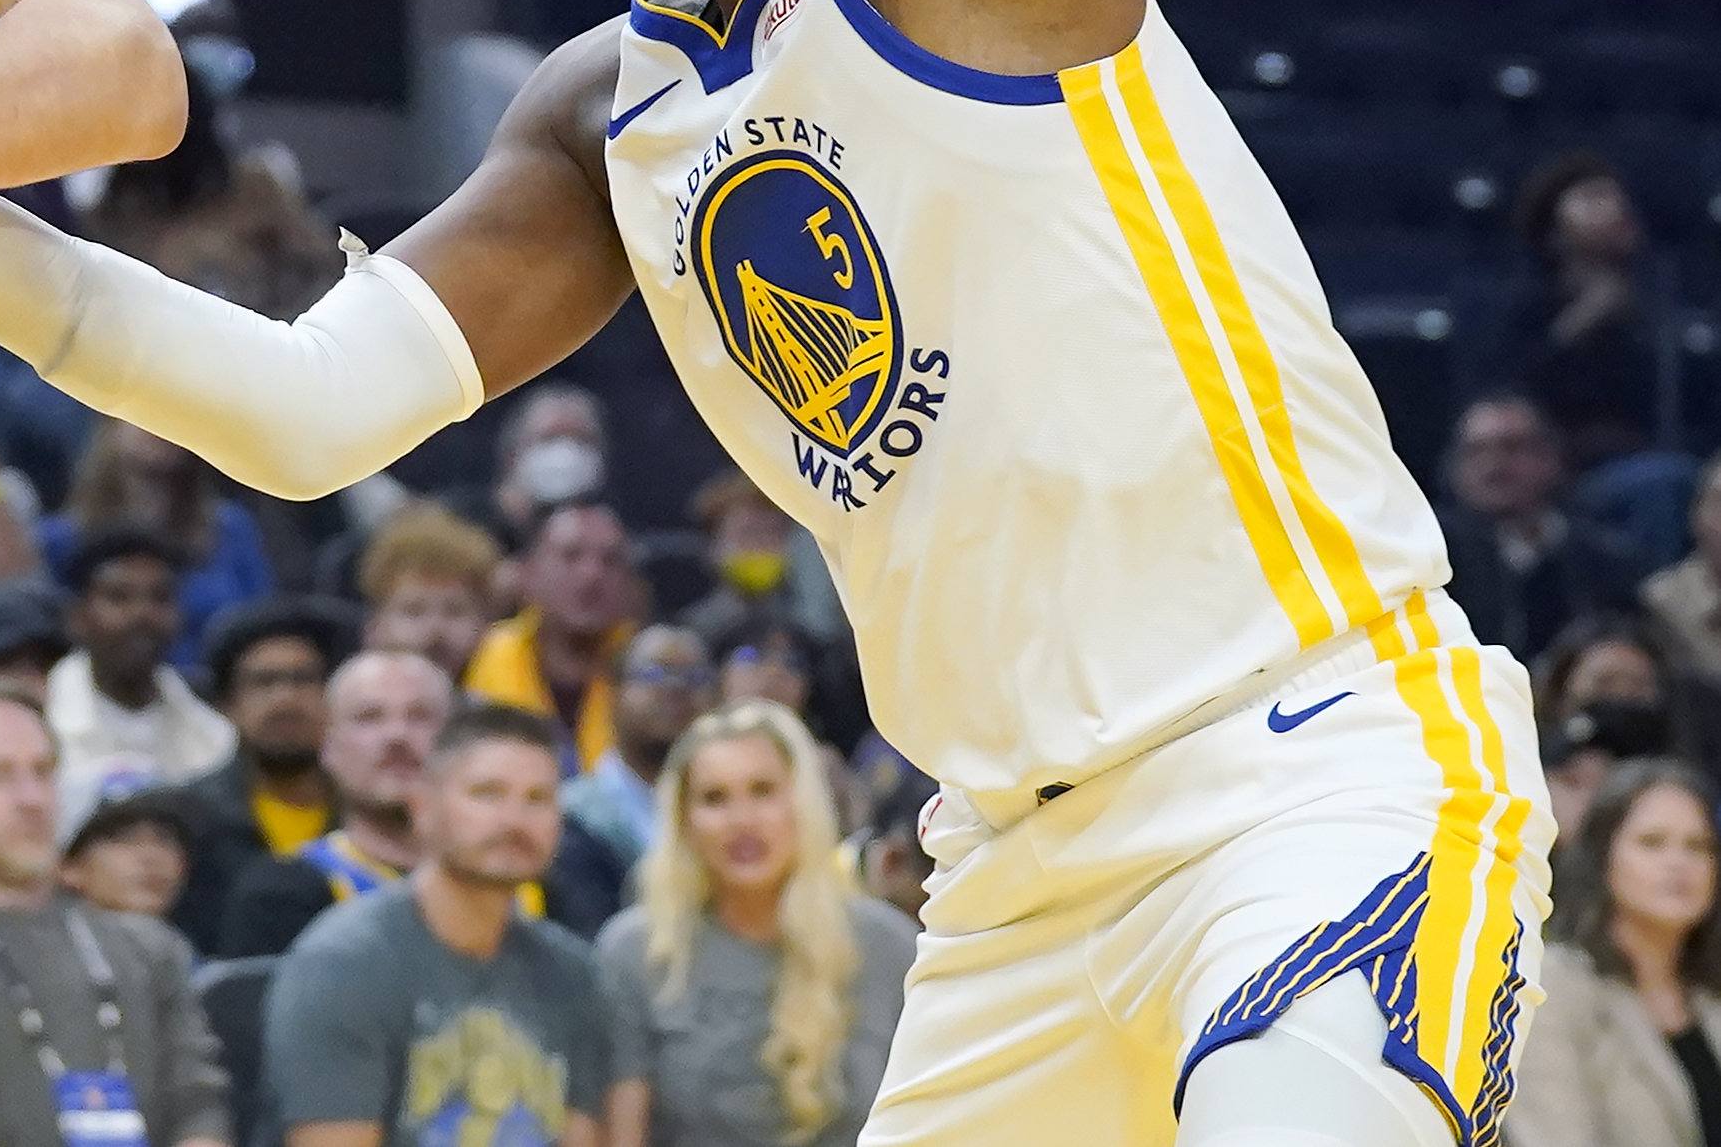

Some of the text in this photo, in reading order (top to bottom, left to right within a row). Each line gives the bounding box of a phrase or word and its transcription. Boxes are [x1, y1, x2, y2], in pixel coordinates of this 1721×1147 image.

[673, 116, 845, 277] GOLDEN STATE
[801, 206, 855, 290] 5
